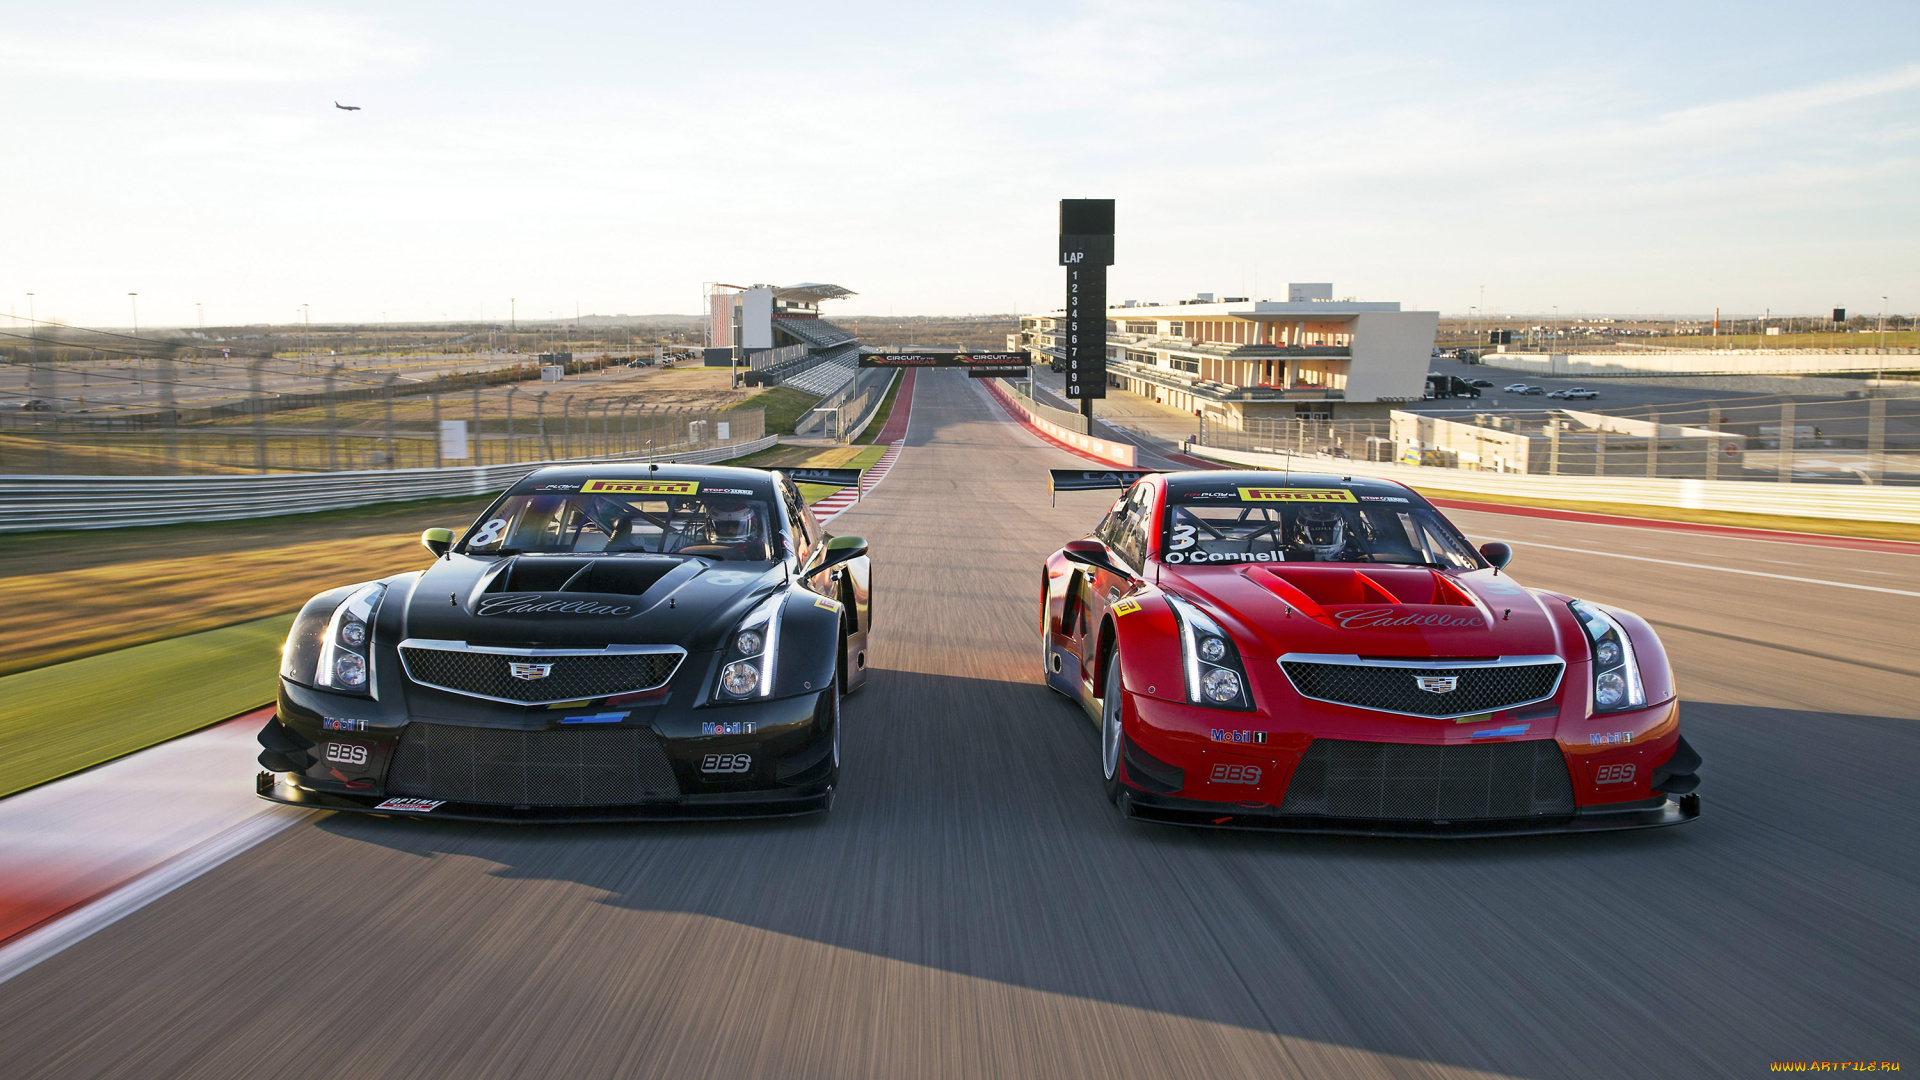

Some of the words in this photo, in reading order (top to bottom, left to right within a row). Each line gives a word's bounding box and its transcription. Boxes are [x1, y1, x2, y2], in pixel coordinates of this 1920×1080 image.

[1063, 252, 1084, 263] LAP
[1072, 271, 1078, 279] 1
[1072, 284, 1078, 293] 2
[1072, 297, 1078, 306] 3
[1072, 309, 1078, 318] 4
[1072, 322, 1078, 331] 5
[1072, 335, 1078, 344] 6
[1072, 348, 1078, 356] 7
[1072, 360, 1078, 369] 8
[1072, 373, 1078, 382] 9
[1069, 386, 1080, 395] 10
[1083, 472, 1149, 480] CAD
[591, 481, 691, 492] PIRELLI
[1248, 489, 1347, 500] PIRELLI
[469, 518, 507, 547] 8
[1169, 525, 1197, 550] 3
[1165, 550, 1286, 564] O'Connell
[706, 571, 753, 586] 8
[477, 594, 631, 617] Cadillac
[1334, 608, 1486, 630] Cadillac
[323, 717, 355, 731] Mobil
[702, 722, 741, 735] Mobil
[1210, 728, 1251, 743] Mobil
[1590, 732, 1622, 746] Mobil
[326, 742, 368, 764] BBS
[701, 754, 752, 773] BBS
[1210, 764, 1262, 785] BBS
[1596, 763, 1636, 784] BBS
